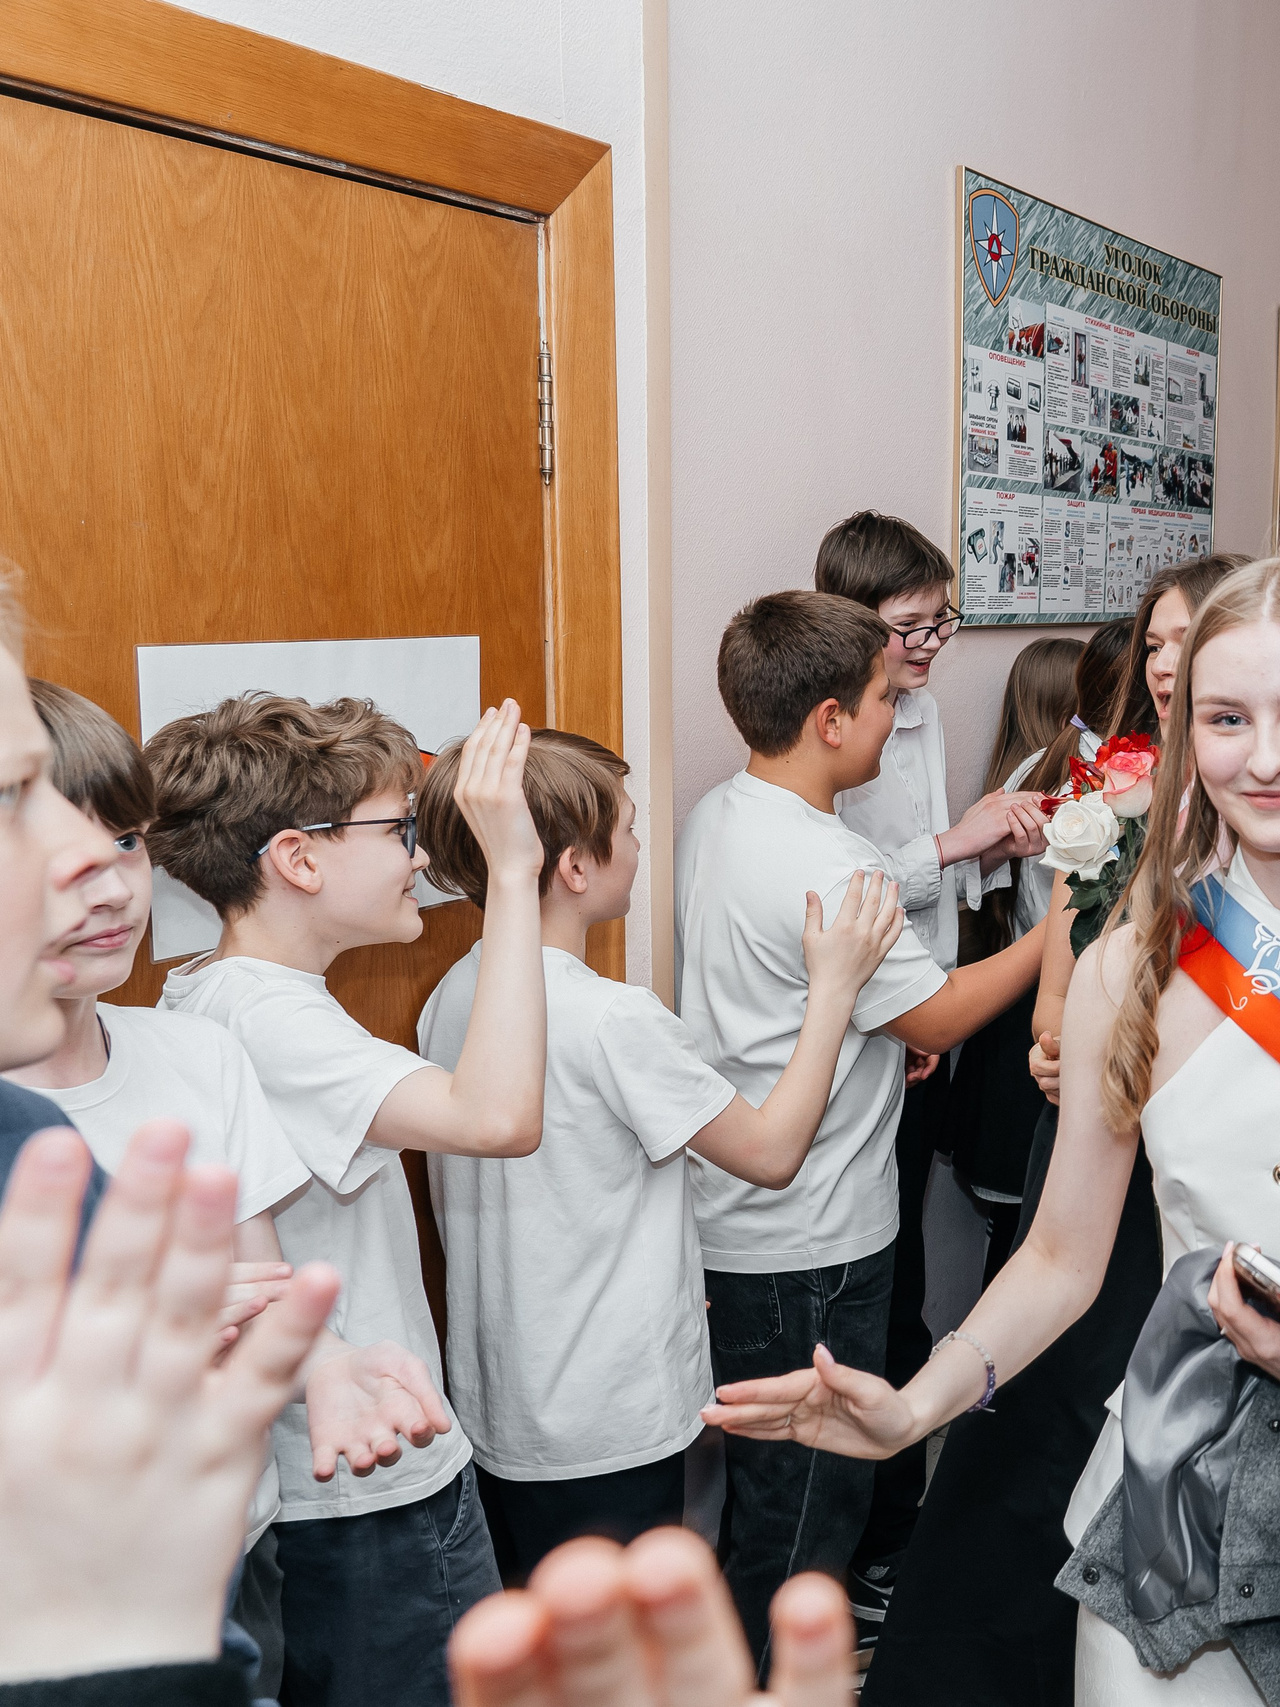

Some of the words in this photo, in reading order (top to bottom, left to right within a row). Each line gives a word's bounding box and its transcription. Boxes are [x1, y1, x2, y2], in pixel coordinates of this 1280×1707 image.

[1104, 244, 1162, 286] УГОЛОК
[1030, 246, 1147, 311] ГРАЖДАНСКОЙ
[1151, 293, 1217, 334] ОБОРОНЫ
[989, 352, 1026, 368] ОПОВЕЩЕНИЕ
[996, 491, 1016, 500] ПОЖАР
[1067, 500, 1085, 508] ЗАЩИТА
